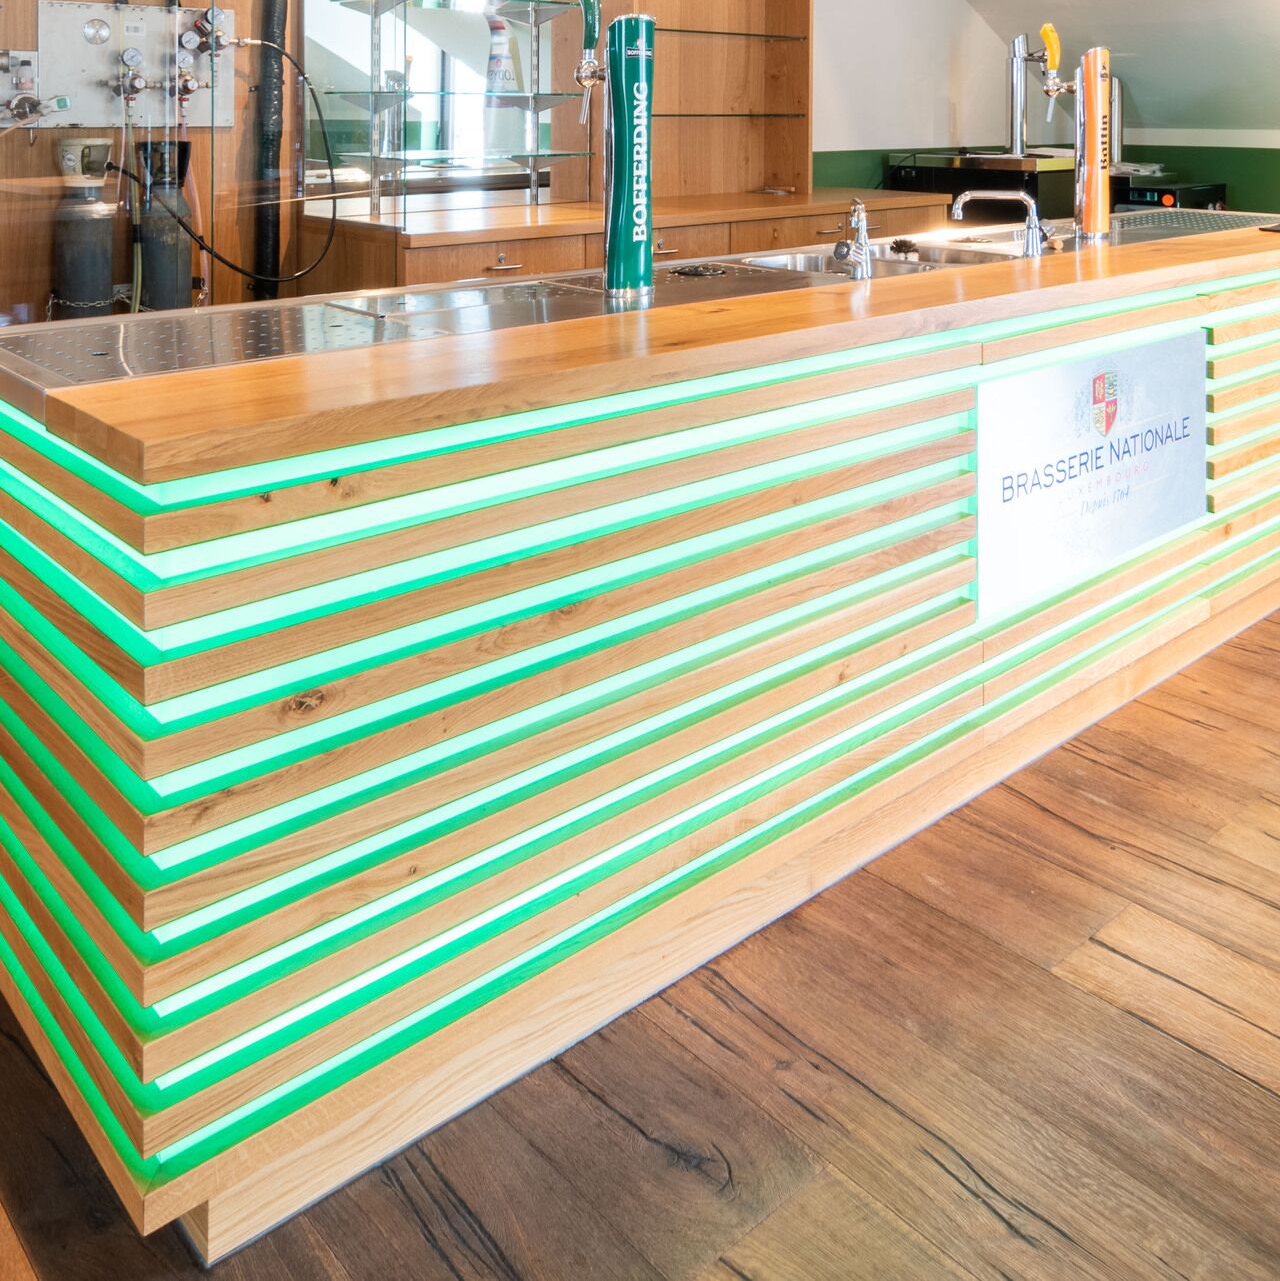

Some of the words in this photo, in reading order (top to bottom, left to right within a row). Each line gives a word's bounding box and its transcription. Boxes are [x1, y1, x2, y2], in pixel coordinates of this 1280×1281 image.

[633, 81, 649, 242] BOFFERDING
[1100, 114, 1108, 170] Battin
[1001, 445, 1105, 504] BRASSERIE
[1109, 415, 1191, 465] NATIONALE
